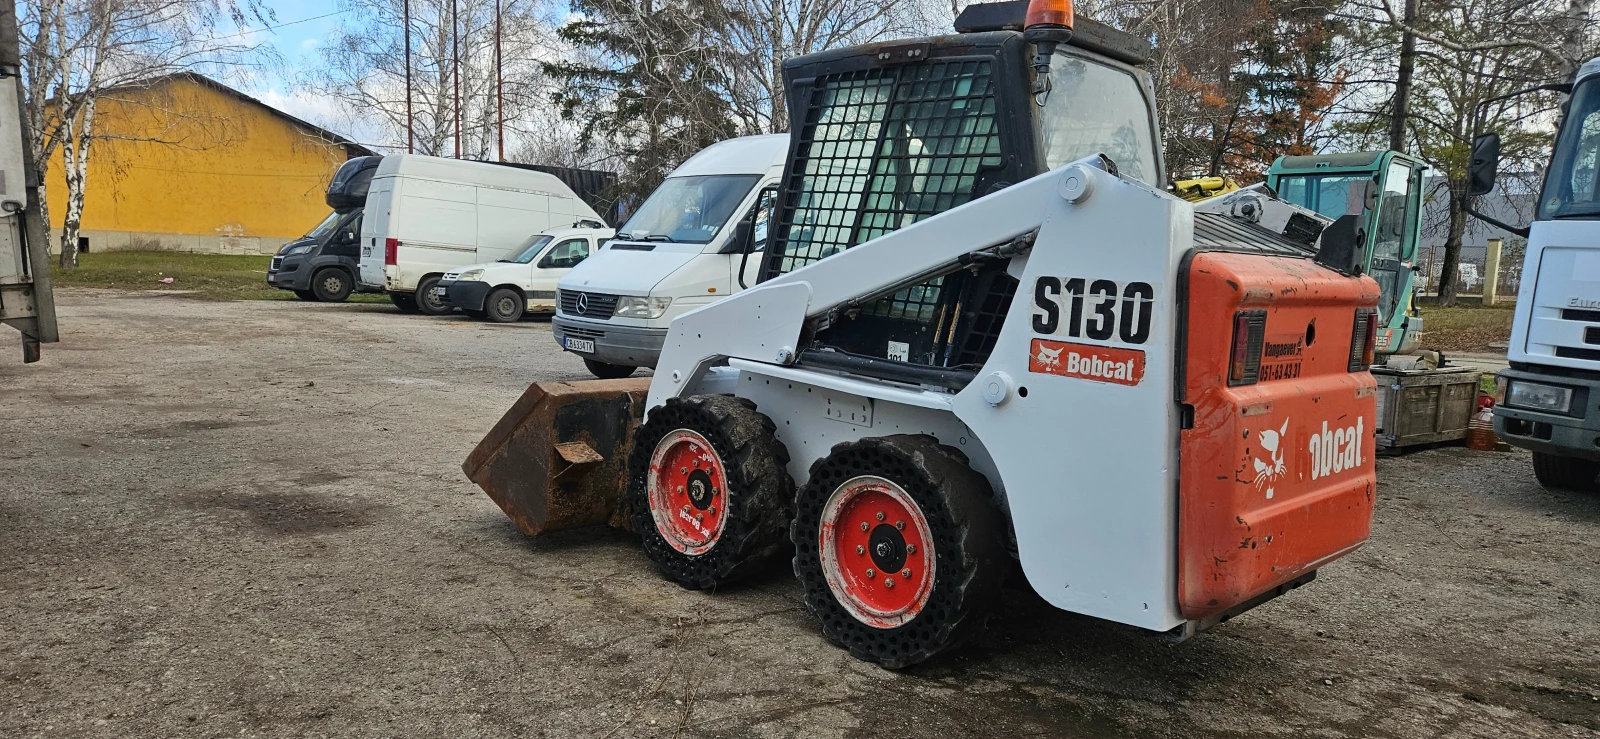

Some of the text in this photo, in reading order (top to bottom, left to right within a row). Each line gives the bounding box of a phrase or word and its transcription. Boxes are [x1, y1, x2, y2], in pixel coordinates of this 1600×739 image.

[1032, 276, 1154, 344] S130
[1265, 342, 1296, 358] Vangaever
[1067, 352, 1134, 381] Bobcat
